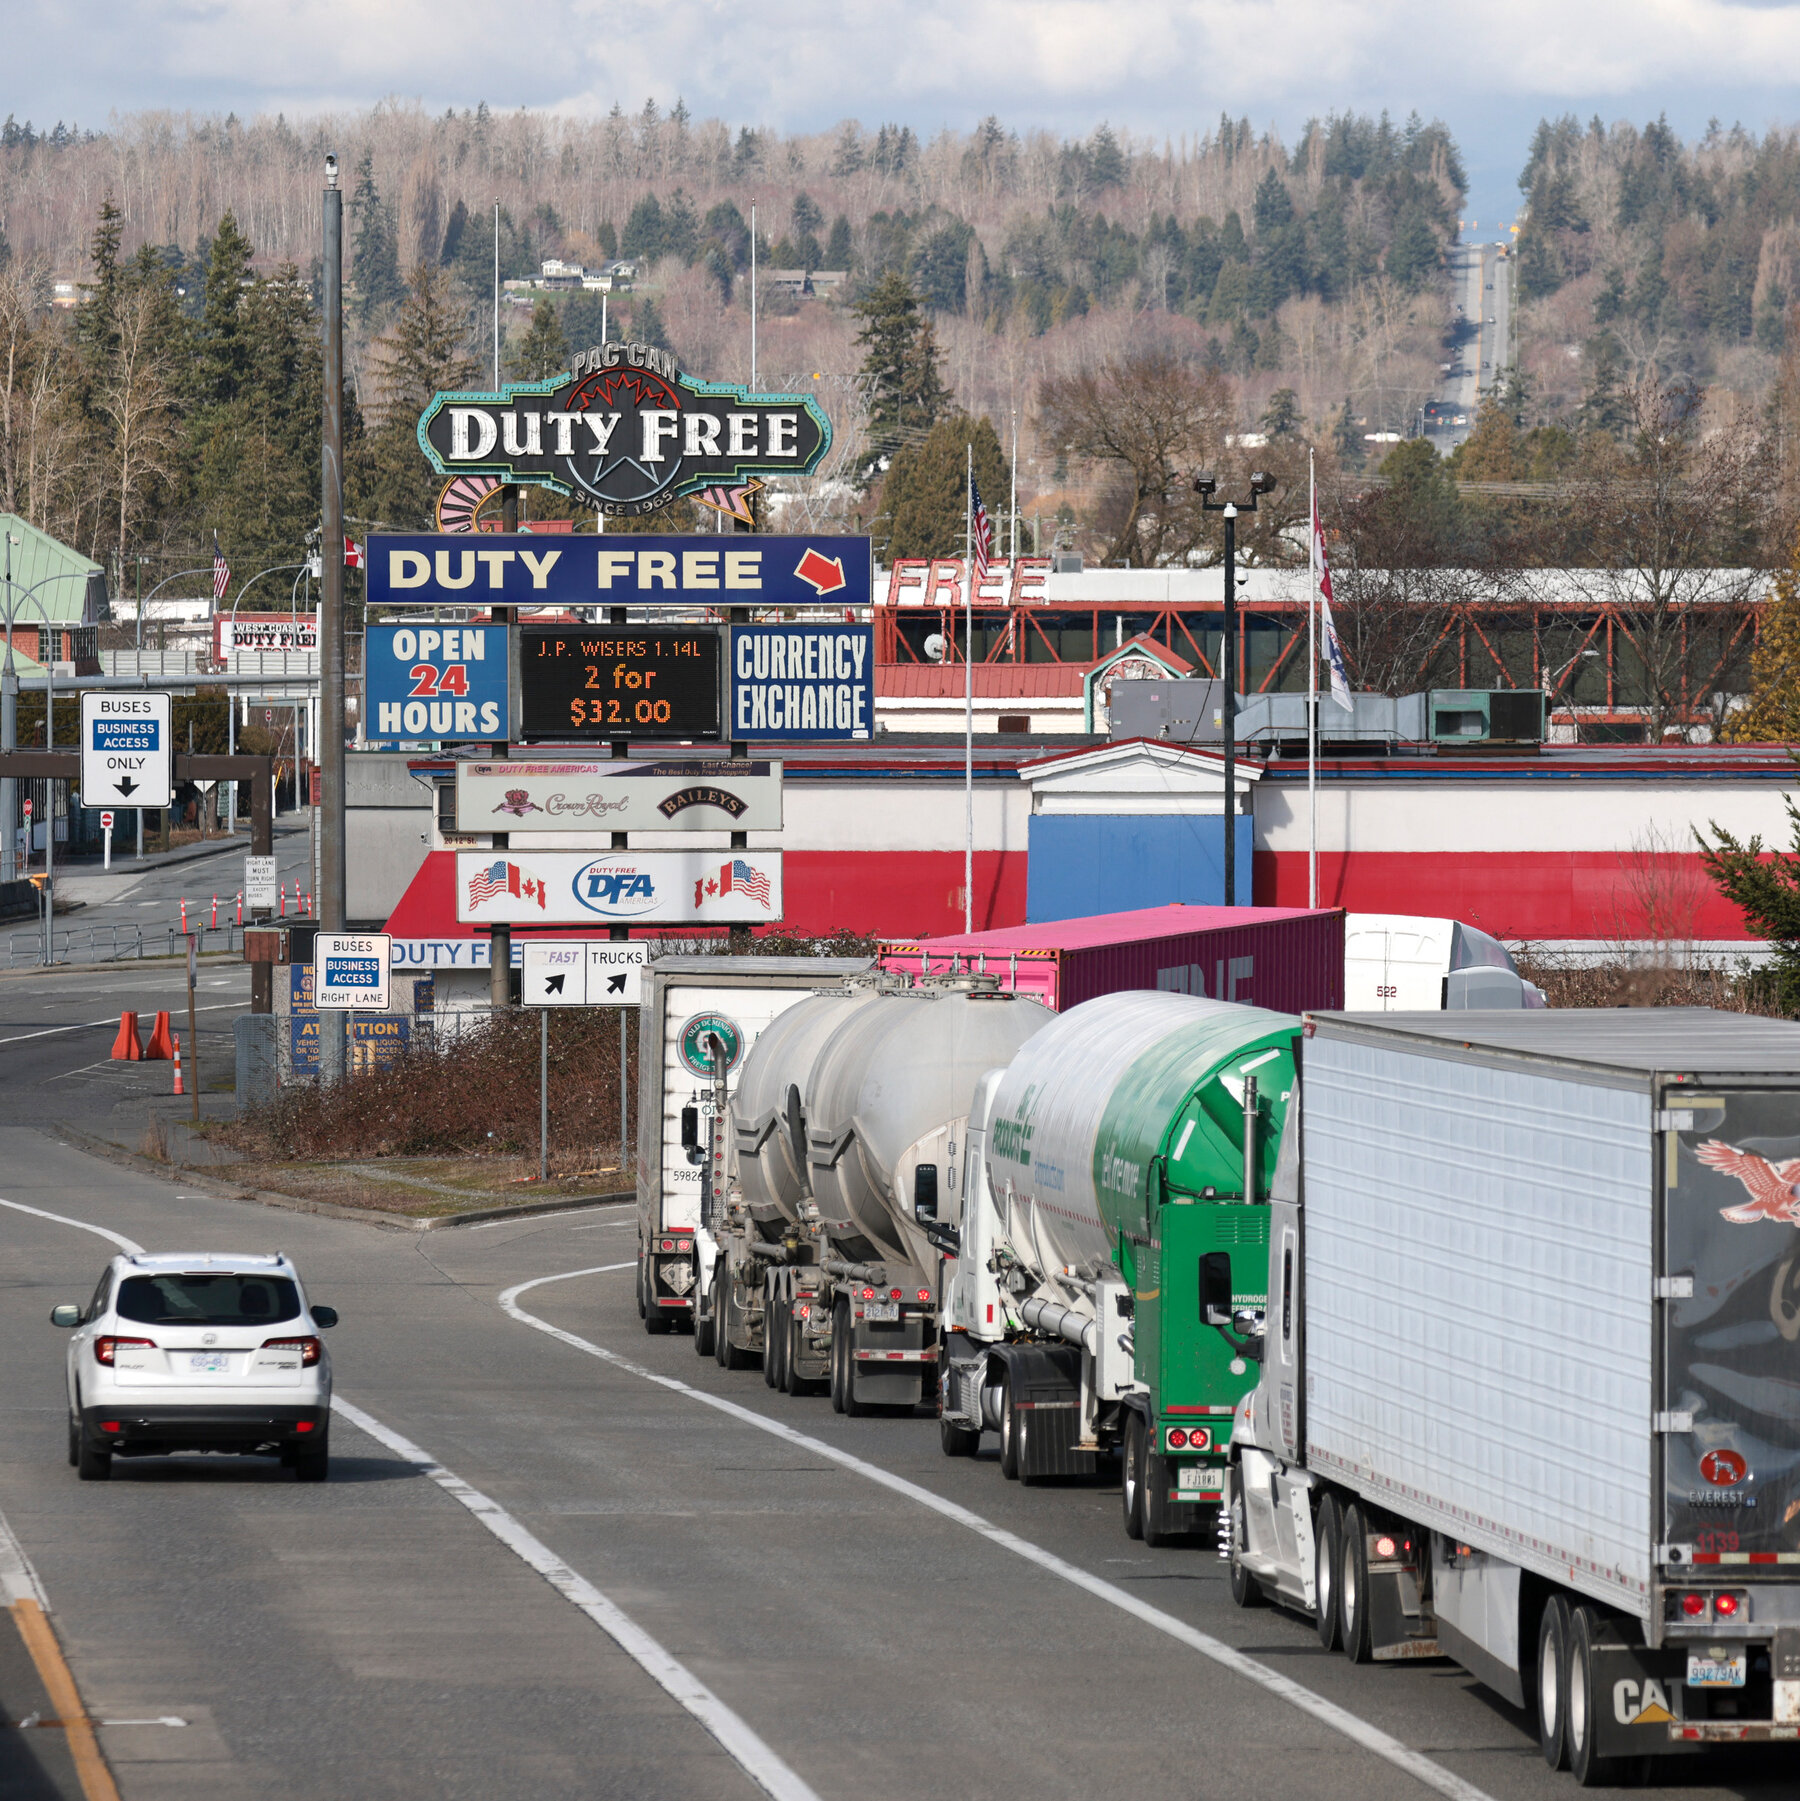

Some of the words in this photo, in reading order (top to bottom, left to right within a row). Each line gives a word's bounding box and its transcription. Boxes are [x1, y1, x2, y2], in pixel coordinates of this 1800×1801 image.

[571, 341, 620, 383] PAC
[627, 341, 677, 384] CAN
[449, 408, 621, 460] DUTY
[640, 410, 797, 462] FREE
[575, 490, 626, 516] SINCE
[634, 490, 674, 515] 1965
[389, 550, 562, 589] DUTY
[597, 550, 762, 589] FREE
[887, 558, 1052, 606] FREE
[235, 623, 265, 633] WEST
[268, 623, 302, 633] COAST
[234, 633, 277, 647] DUTY
[392, 629, 485, 661] OPEN
[538, 641, 572, 656] J.P.
[580, 641, 647, 656] WISERS
[655, 641, 701, 656] 1.14L
[737, 634, 867, 679] CURRENCY
[407, 664, 470, 697] 24
[584, 665, 600, 689] 2
[613, 663, 657, 689] for
[101, 701, 151, 713] BUSES
[570, 698, 671, 727] $32.00
[737, 684, 866, 730] EXCHANGE
[378, 701, 500, 734] HOURS
[97, 723, 155, 734] BUSINESS
[103, 737, 149, 748] ACCESS
[107, 757, 146, 769] ONLY
[499, 764, 523, 773] DUTY
[525, 764, 549, 773] FREE
[550, 764, 599, 774] AMERICAS
[545, 793, 586, 816] Crown
[573, 793, 630, 817] Royal
[664, 789, 740, 814] BAILEYS
[587, 874, 655, 904] DFA
[619, 897, 658, 905] AMERICAS
[333, 941, 373, 952] BUSES
[391, 944, 463, 964] DUTY
[327, 961, 378, 971] BUSINESS
[548, 951, 579, 963] FAST
[592, 951, 643, 964] TRUCKS
[332, 973, 373, 984] ACCESS
[321, 993, 351, 1002] RIGHT
[355, 993, 383, 1003] LANE
[687, 1023, 701, 1037] OLD
[701, 1020, 734, 1038] DOMINION
[1689, 1490, 1745, 1503] EVEREST
[1697, 1531, 1740, 1553] 1139
[1613, 1678, 1688, 1725] CAT
